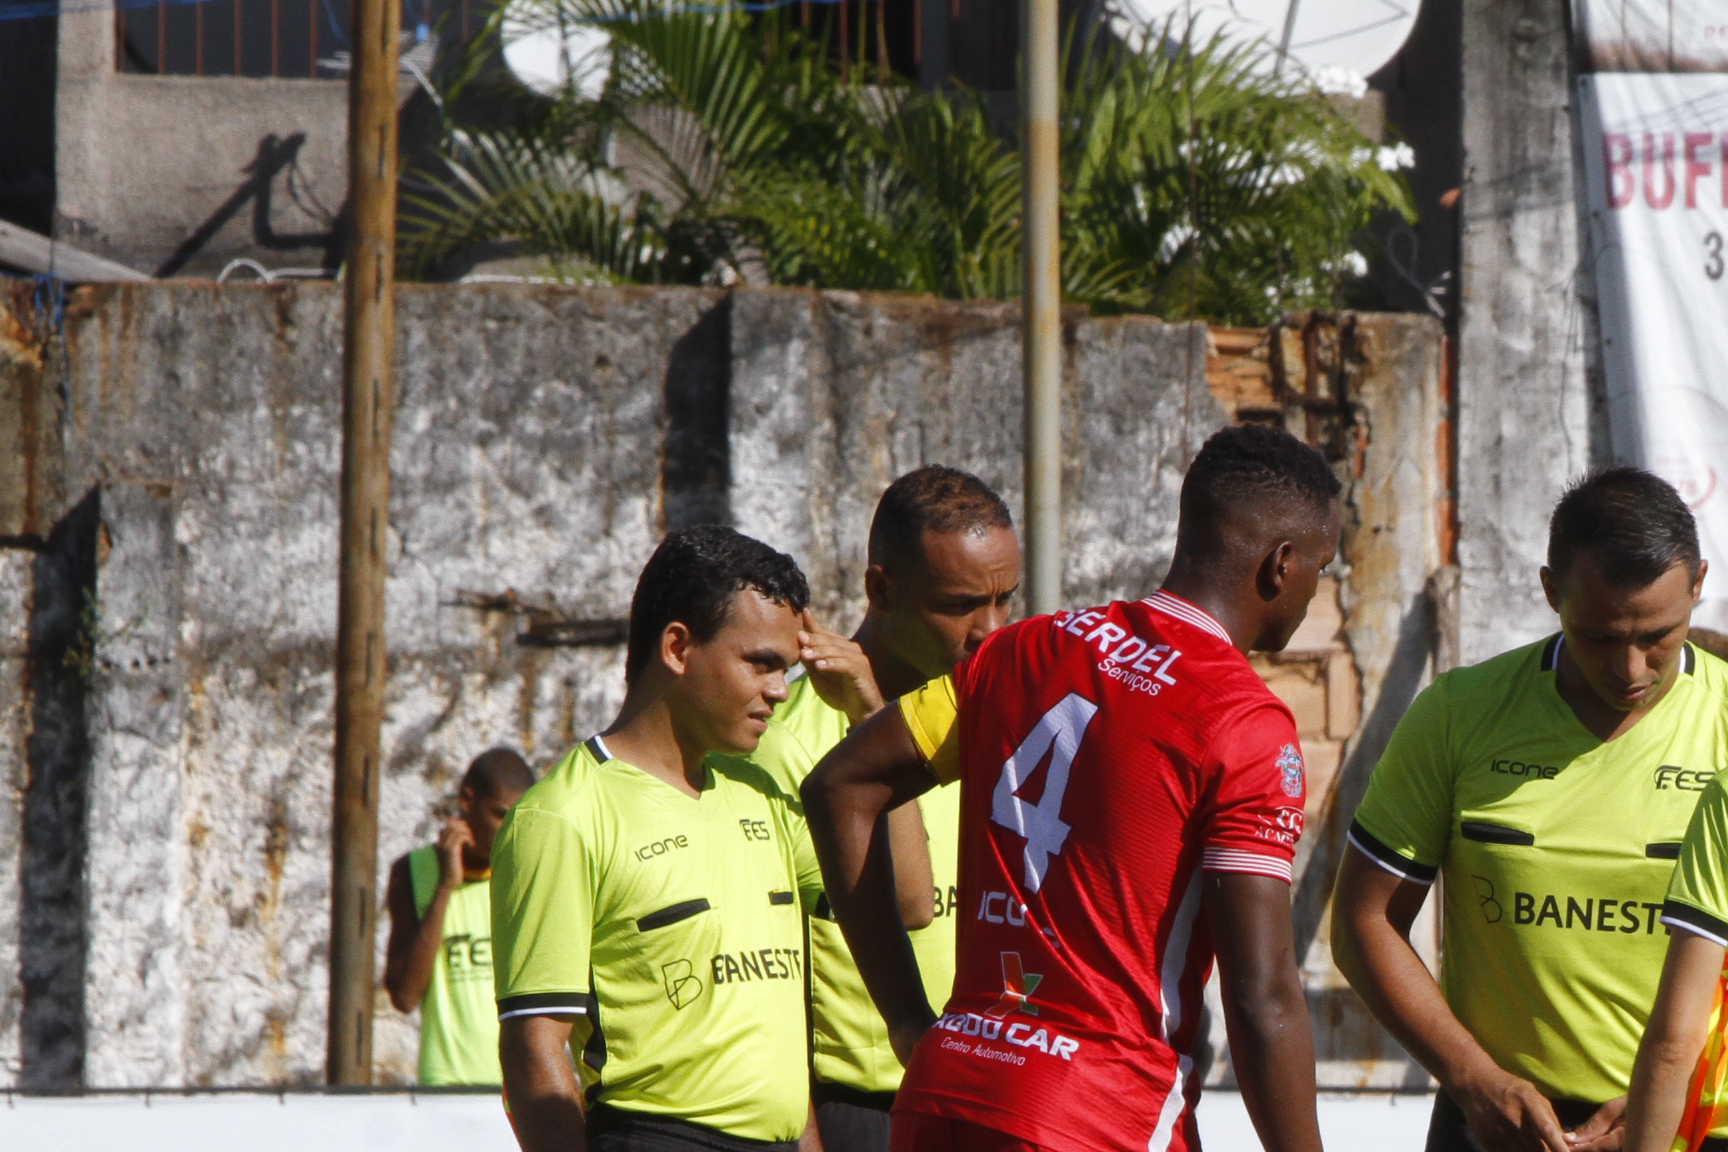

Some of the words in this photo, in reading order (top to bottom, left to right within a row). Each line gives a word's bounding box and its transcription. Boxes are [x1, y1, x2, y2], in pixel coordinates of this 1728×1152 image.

[1054, 609, 1182, 686] SERDEL
[1098, 658, 1161, 696] Serviços
[990, 692, 1099, 894] 4
[1653, 764, 1717, 792] FES
[739, 819, 770, 842] FES
[1514, 892, 1672, 936] BANEST
[443, 933, 492, 966] FE
[940, 1036, 971, 1053] Centro
[971, 1043, 1026, 1067] Automotivo
[1005, 1022, 1080, 1061] CAR
